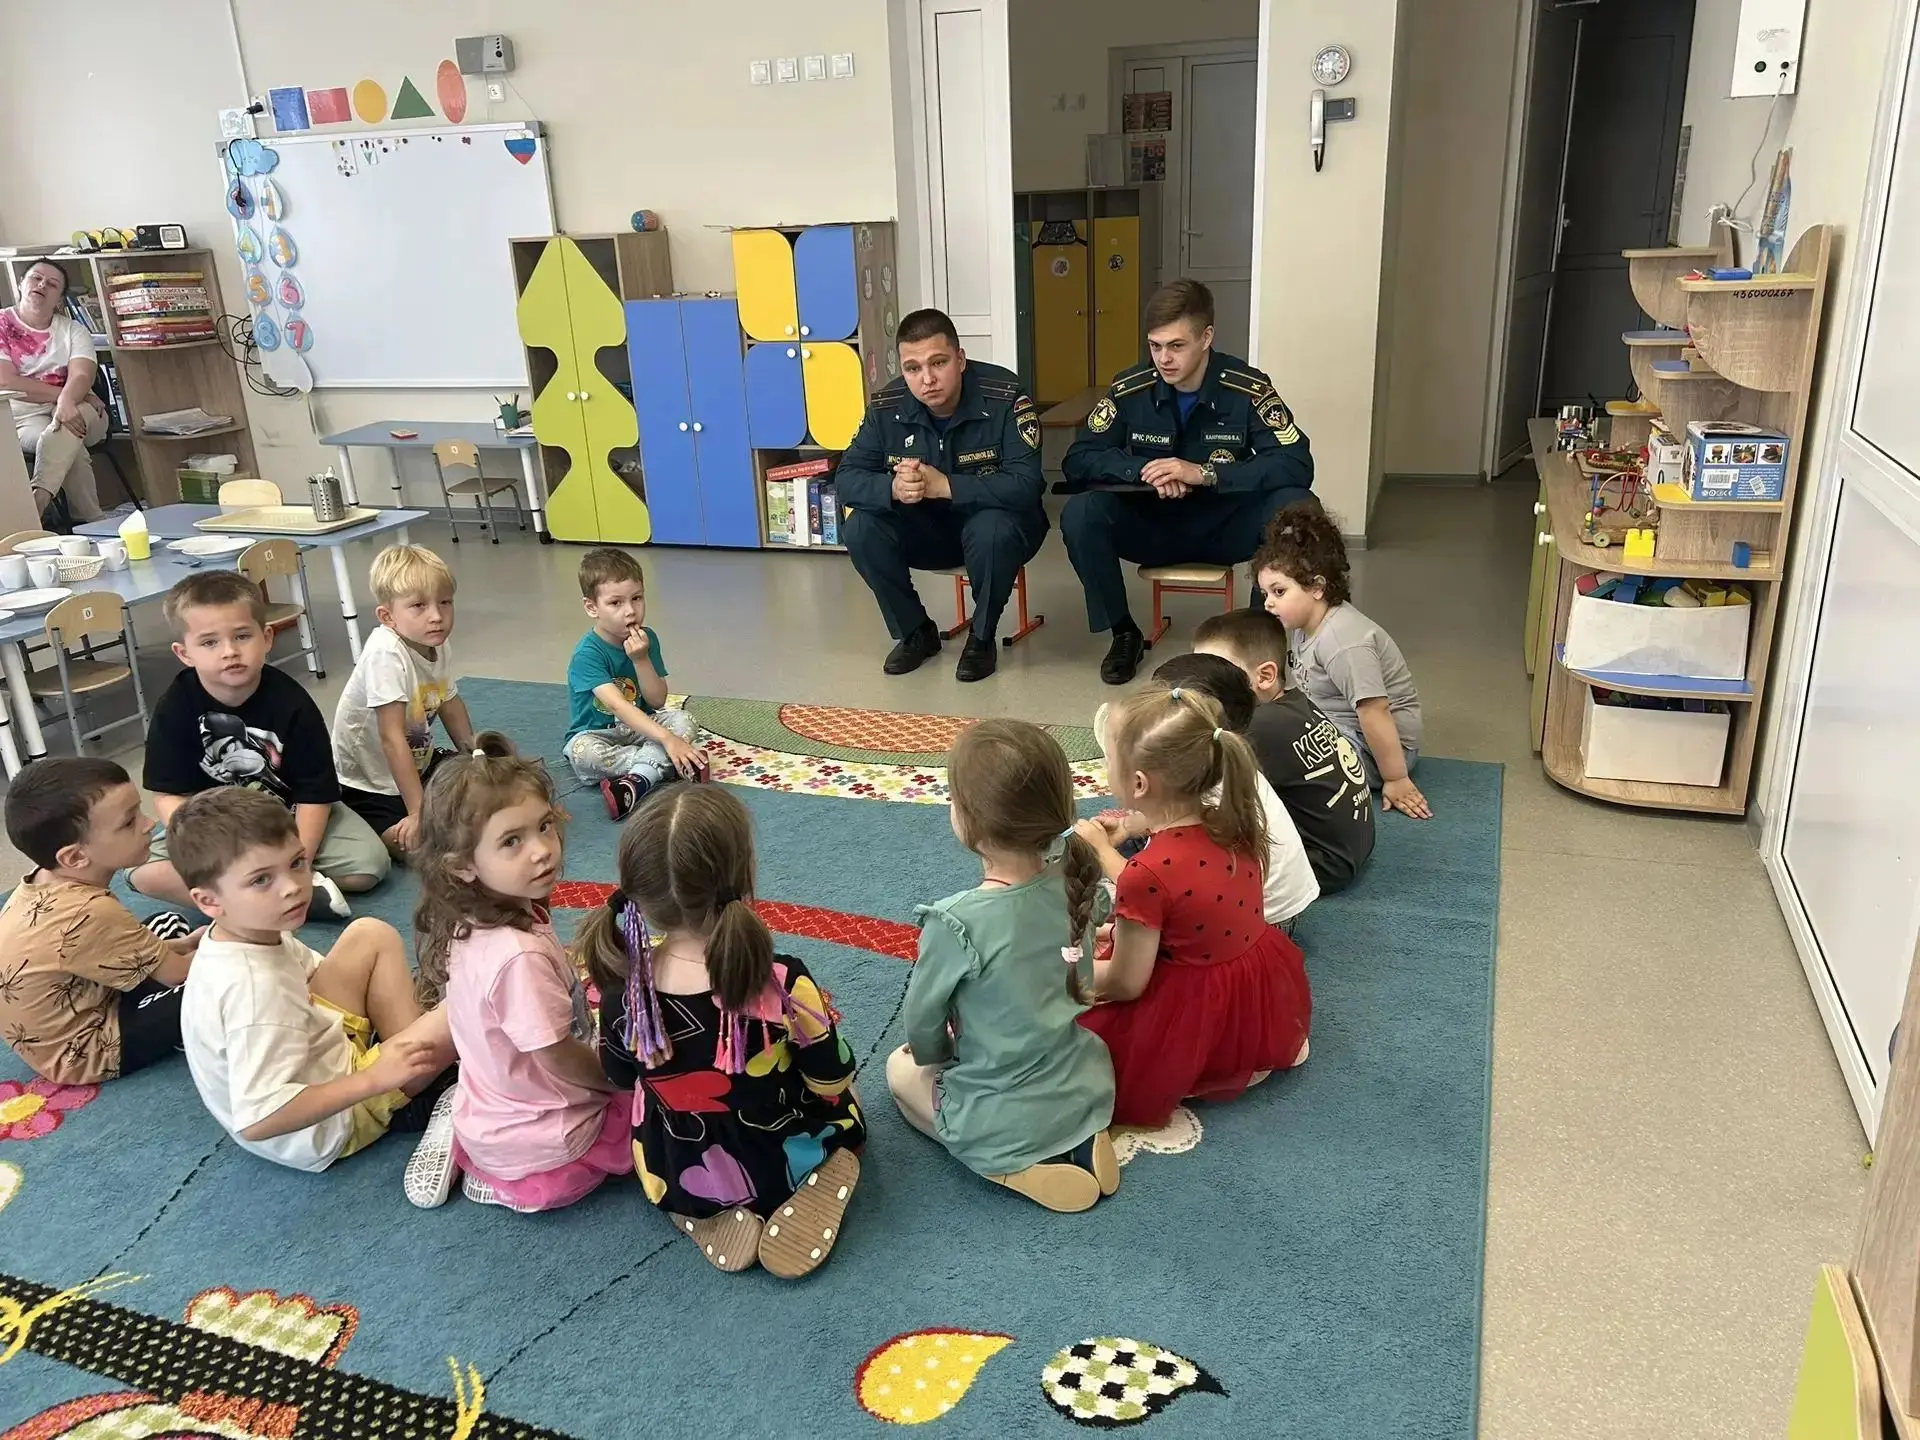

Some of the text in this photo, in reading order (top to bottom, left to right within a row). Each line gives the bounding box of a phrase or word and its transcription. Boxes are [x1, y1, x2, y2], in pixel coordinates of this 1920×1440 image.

[248, 275, 268, 304] 5
[280, 278, 300, 304] 6
[258, 321, 277, 347] 8
[286, 320, 305, 348] 7
[1145, 434, 1170, 444] РОССИИ
[1292, 719, 1340, 770] KEEP
[1352, 788, 1370, 807] SMIL
